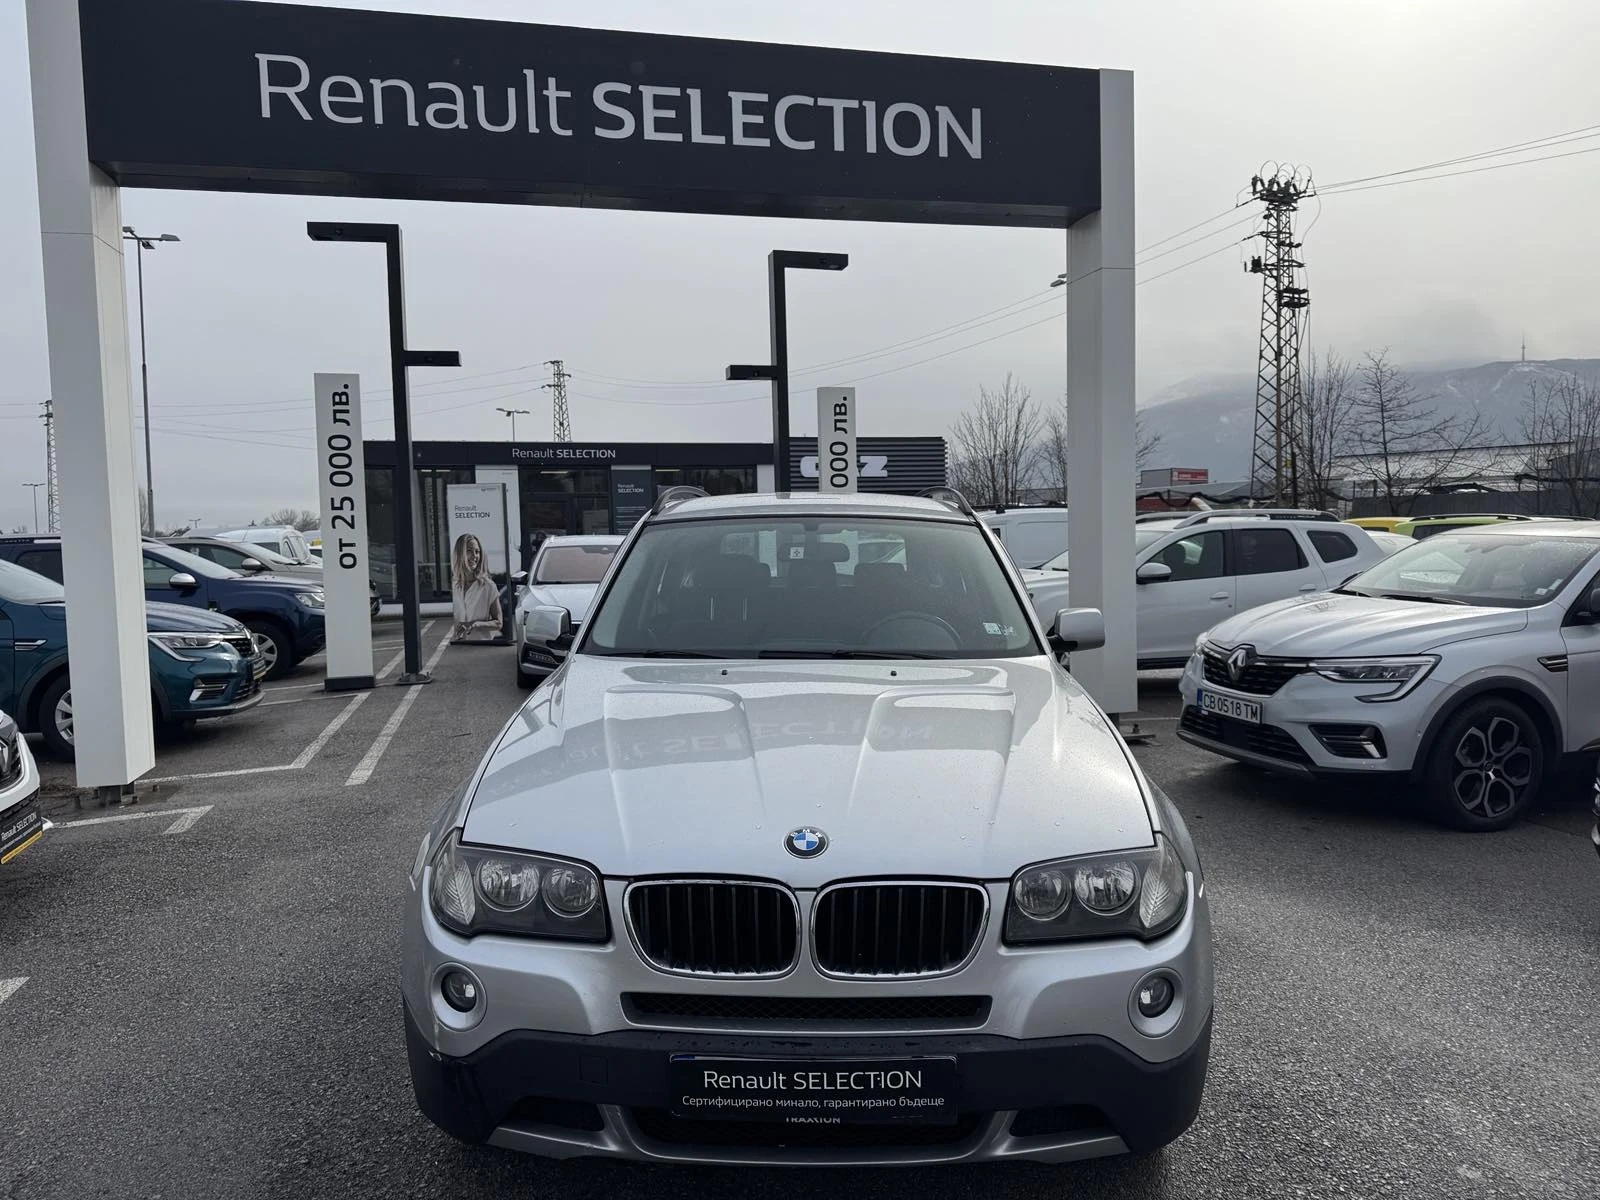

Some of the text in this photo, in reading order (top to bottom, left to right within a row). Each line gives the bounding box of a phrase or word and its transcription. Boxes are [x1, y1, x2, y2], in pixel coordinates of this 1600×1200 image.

[254, 53, 982, 159] Renault SELECTION
[327, 434, 353, 487] 000
[512, 448, 616, 459] Renault SELECTION
[829, 441, 849, 488] 000
[330, 496, 355, 529] 25
[338, 538, 357, 569] от
[1203, 694, 1258, 720] CB 0518 TM
[704, 1070, 922, 1090] Renault SELECTION
[682, 1096, 945, 1109] Сертифицирано минало, гарантирано бъдеще
